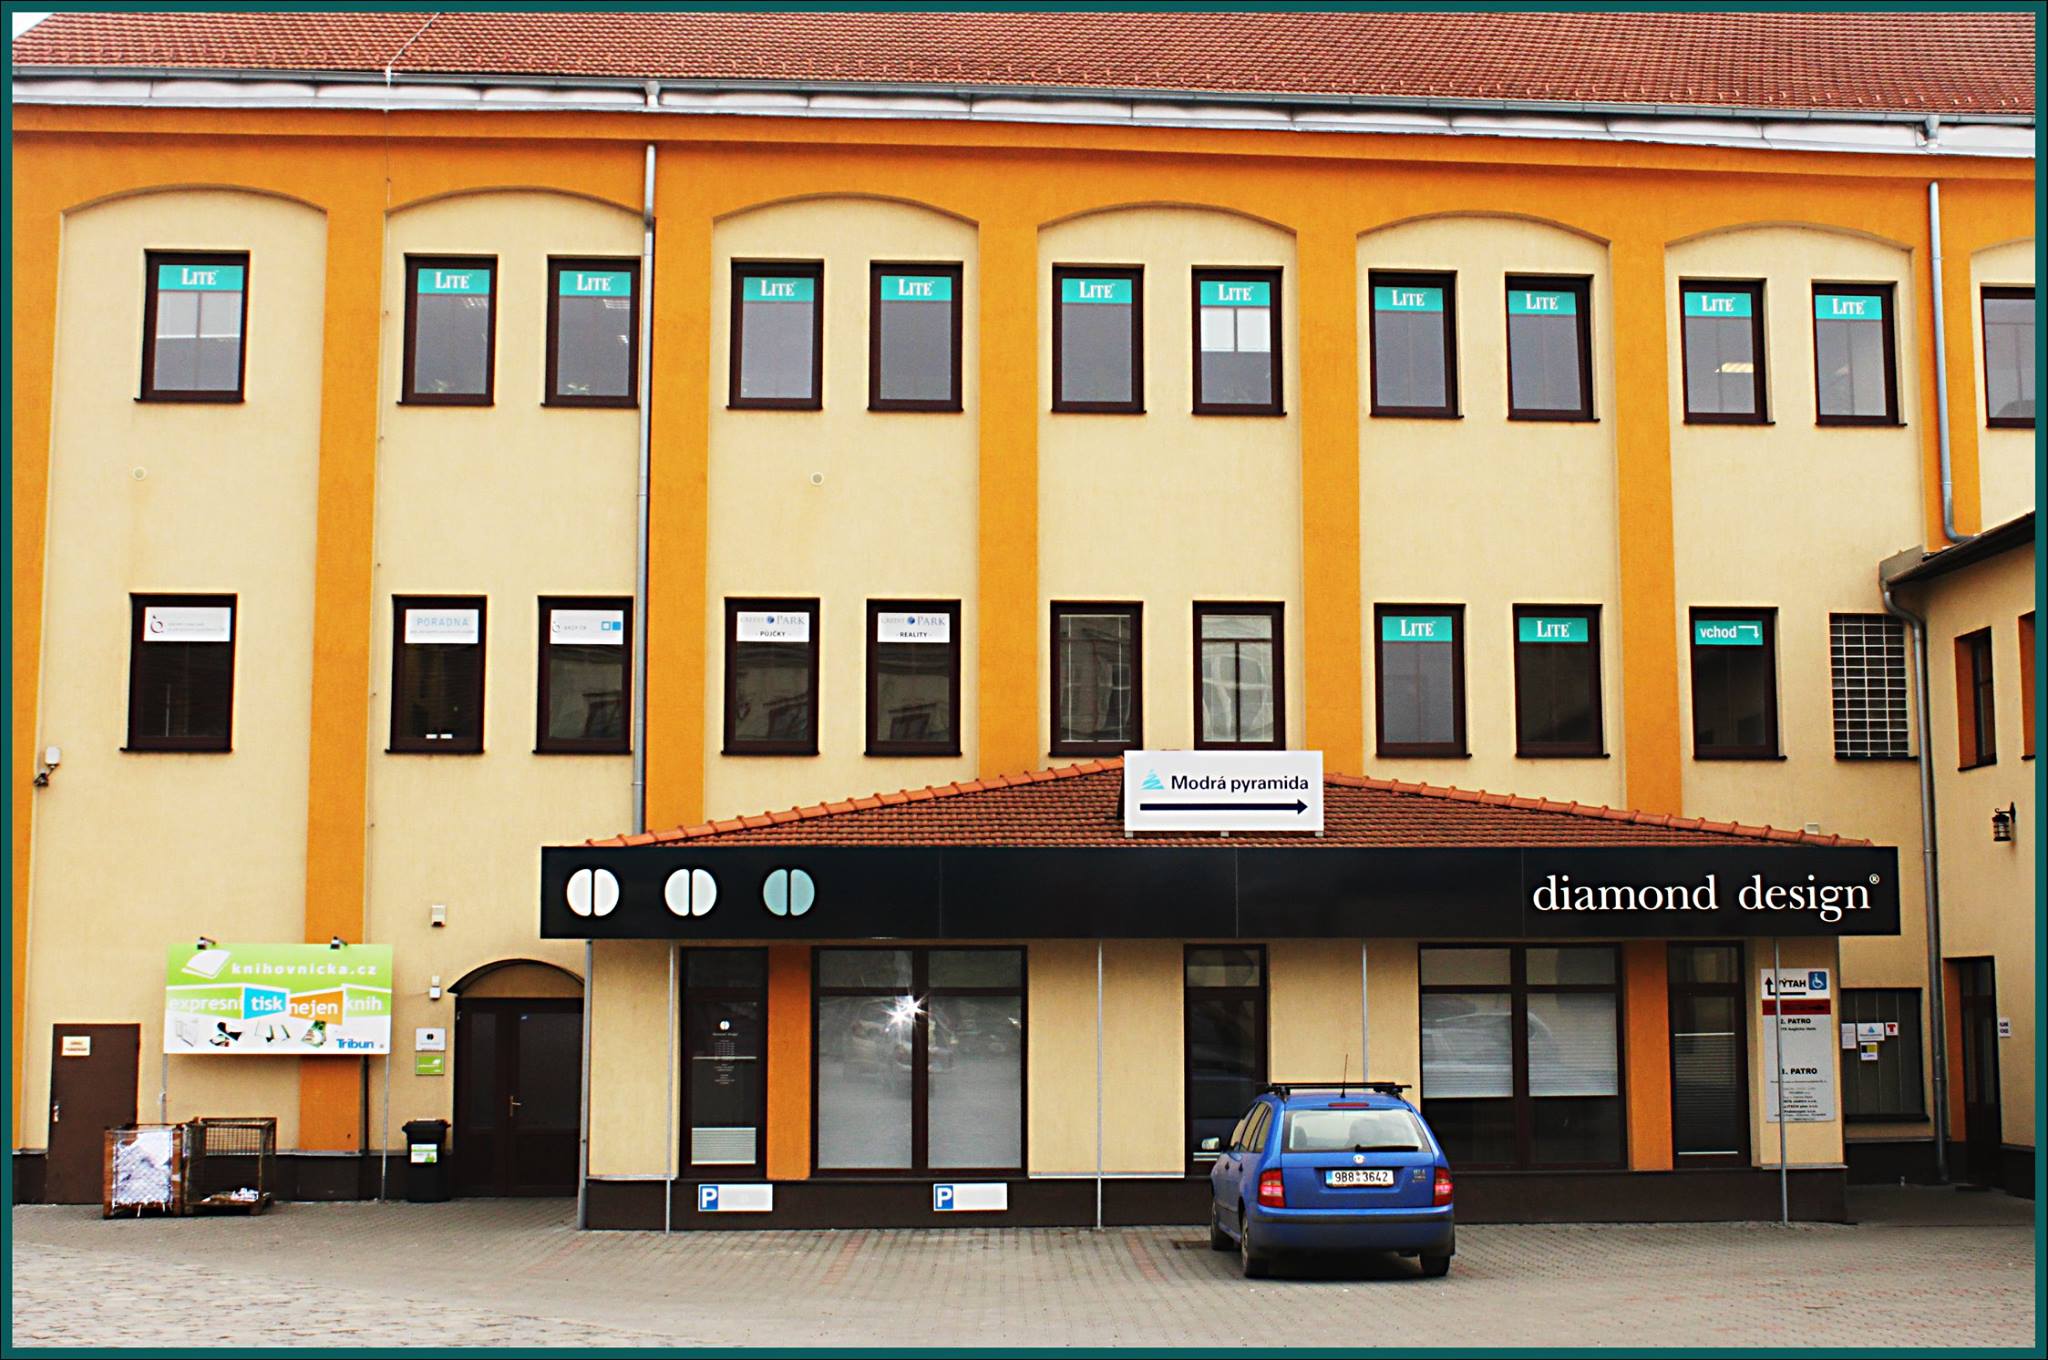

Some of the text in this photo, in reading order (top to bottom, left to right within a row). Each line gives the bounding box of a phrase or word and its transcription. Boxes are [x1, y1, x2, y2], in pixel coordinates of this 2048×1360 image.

[416, 617, 469, 627] PORADNA
[777, 615, 805, 625] PARK
[917, 616, 946, 626] PARK
[1700, 625, 1737, 638] vchod
[1171, 775, 1309, 793] Modrá pyramida
[1533, 874, 1720, 912] diamond
[231, 963, 377, 976] knihovnicka.cz
[1778, 978, 1806, 988] ÝTAH
[251, 996, 283, 1011] tisk
[289, 1000, 338, 1018] nejen
[336, 1039, 374, 1049] Tribun
[1790, 1067, 1817, 1075] PATRO
[1335, 1171, 1388, 1183] 9B8 3642
[702, 1188, 717, 1208] P
[937, 1187, 952, 1208] P
